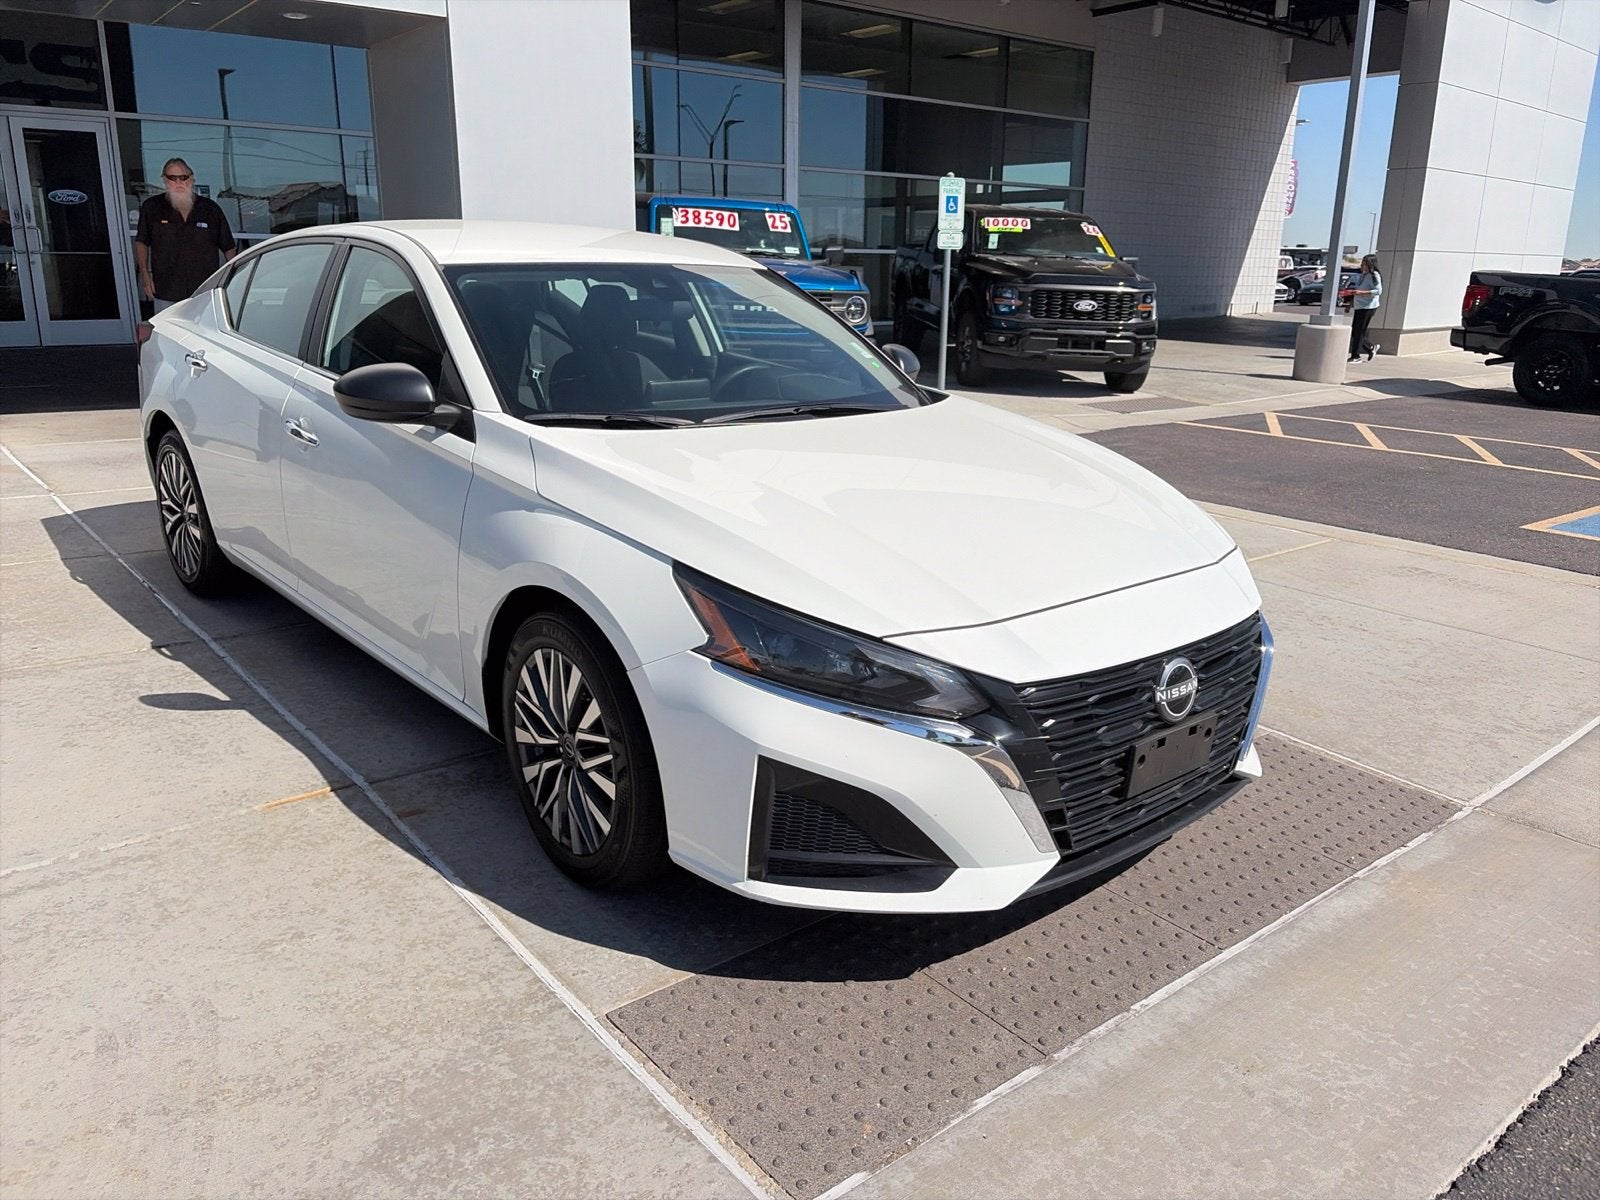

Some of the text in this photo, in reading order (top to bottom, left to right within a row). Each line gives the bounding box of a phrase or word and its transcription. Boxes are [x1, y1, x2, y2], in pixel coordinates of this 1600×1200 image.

[54, 191, 82, 202] Ford
[769, 213, 789, 230] 25
[1156, 677, 1198, 702] NISSAN
